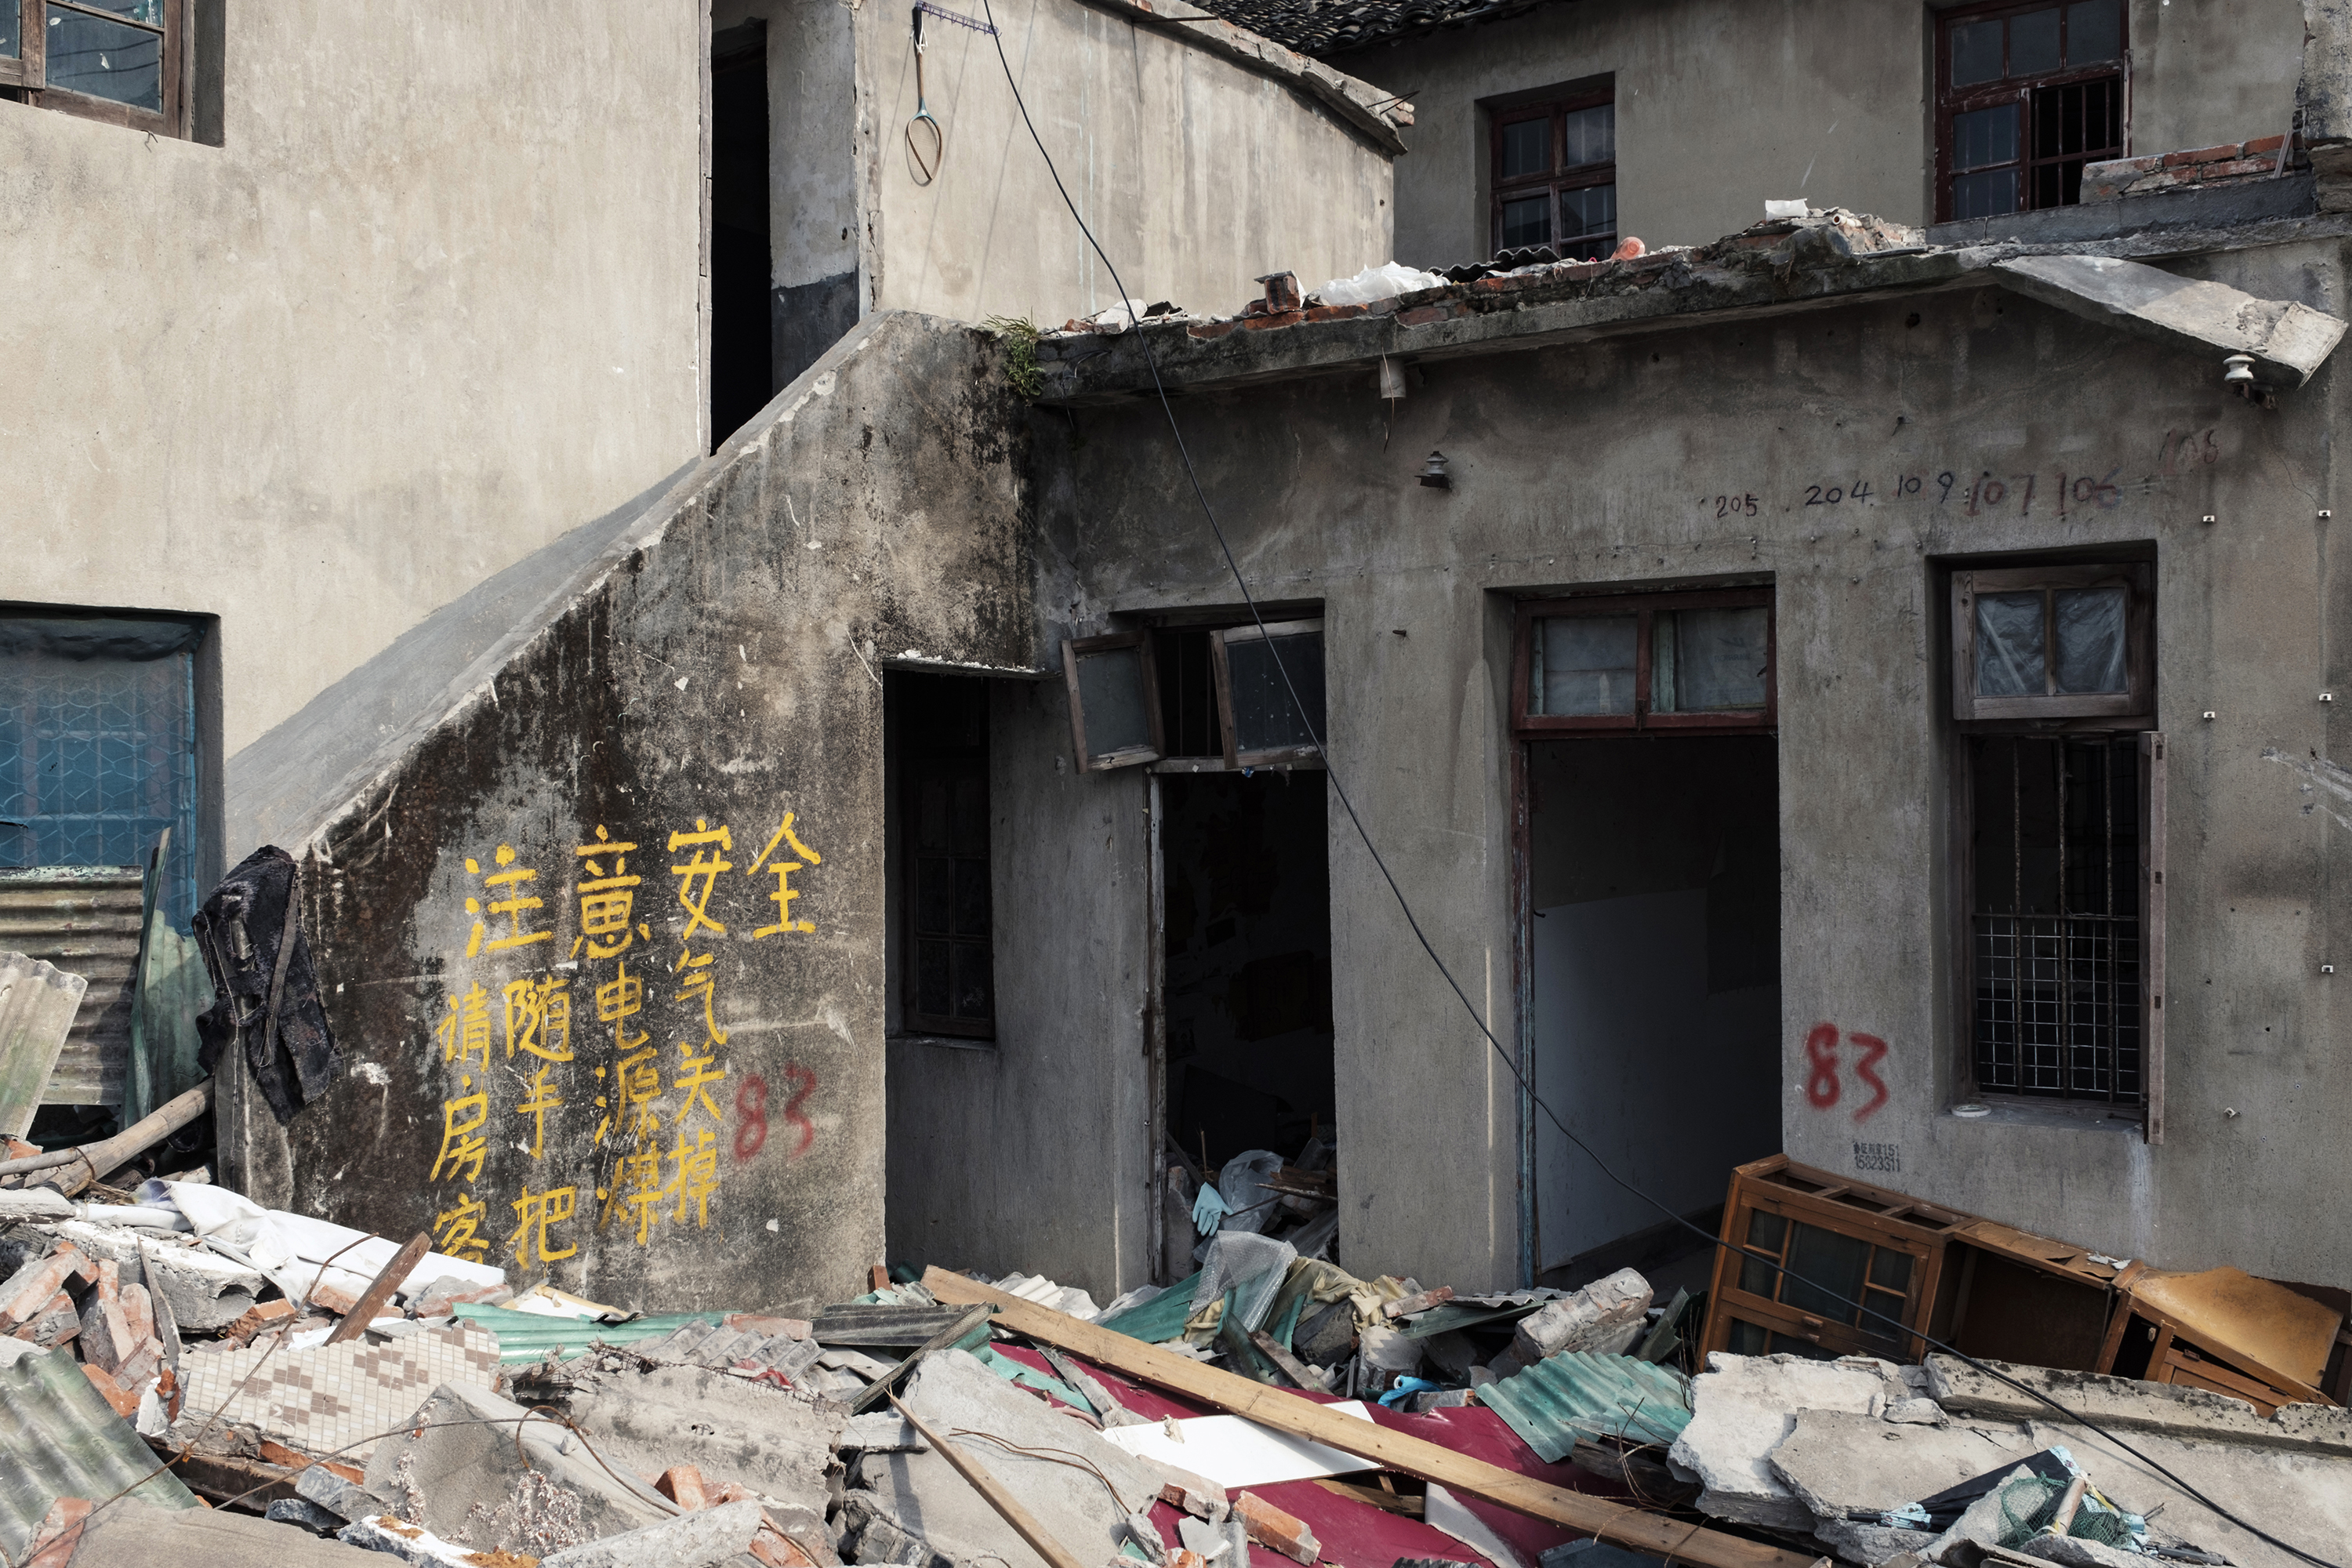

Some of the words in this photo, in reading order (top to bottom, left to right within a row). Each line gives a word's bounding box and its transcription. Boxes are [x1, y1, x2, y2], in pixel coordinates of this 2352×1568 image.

[1716, 493, 1759, 518] 205
[1805, 481, 1875, 506] 204
[464, 811, 821, 959] 注意安全
[430, 981, 492, 1264] 请房客
[503, 974, 578, 1269] 随手把
[593, 961, 664, 1246] 电源煤
[666, 948, 728, 1229] 气关掉
[734, 1061, 818, 1163] 83
[1806, 1022, 1890, 1123] 83
